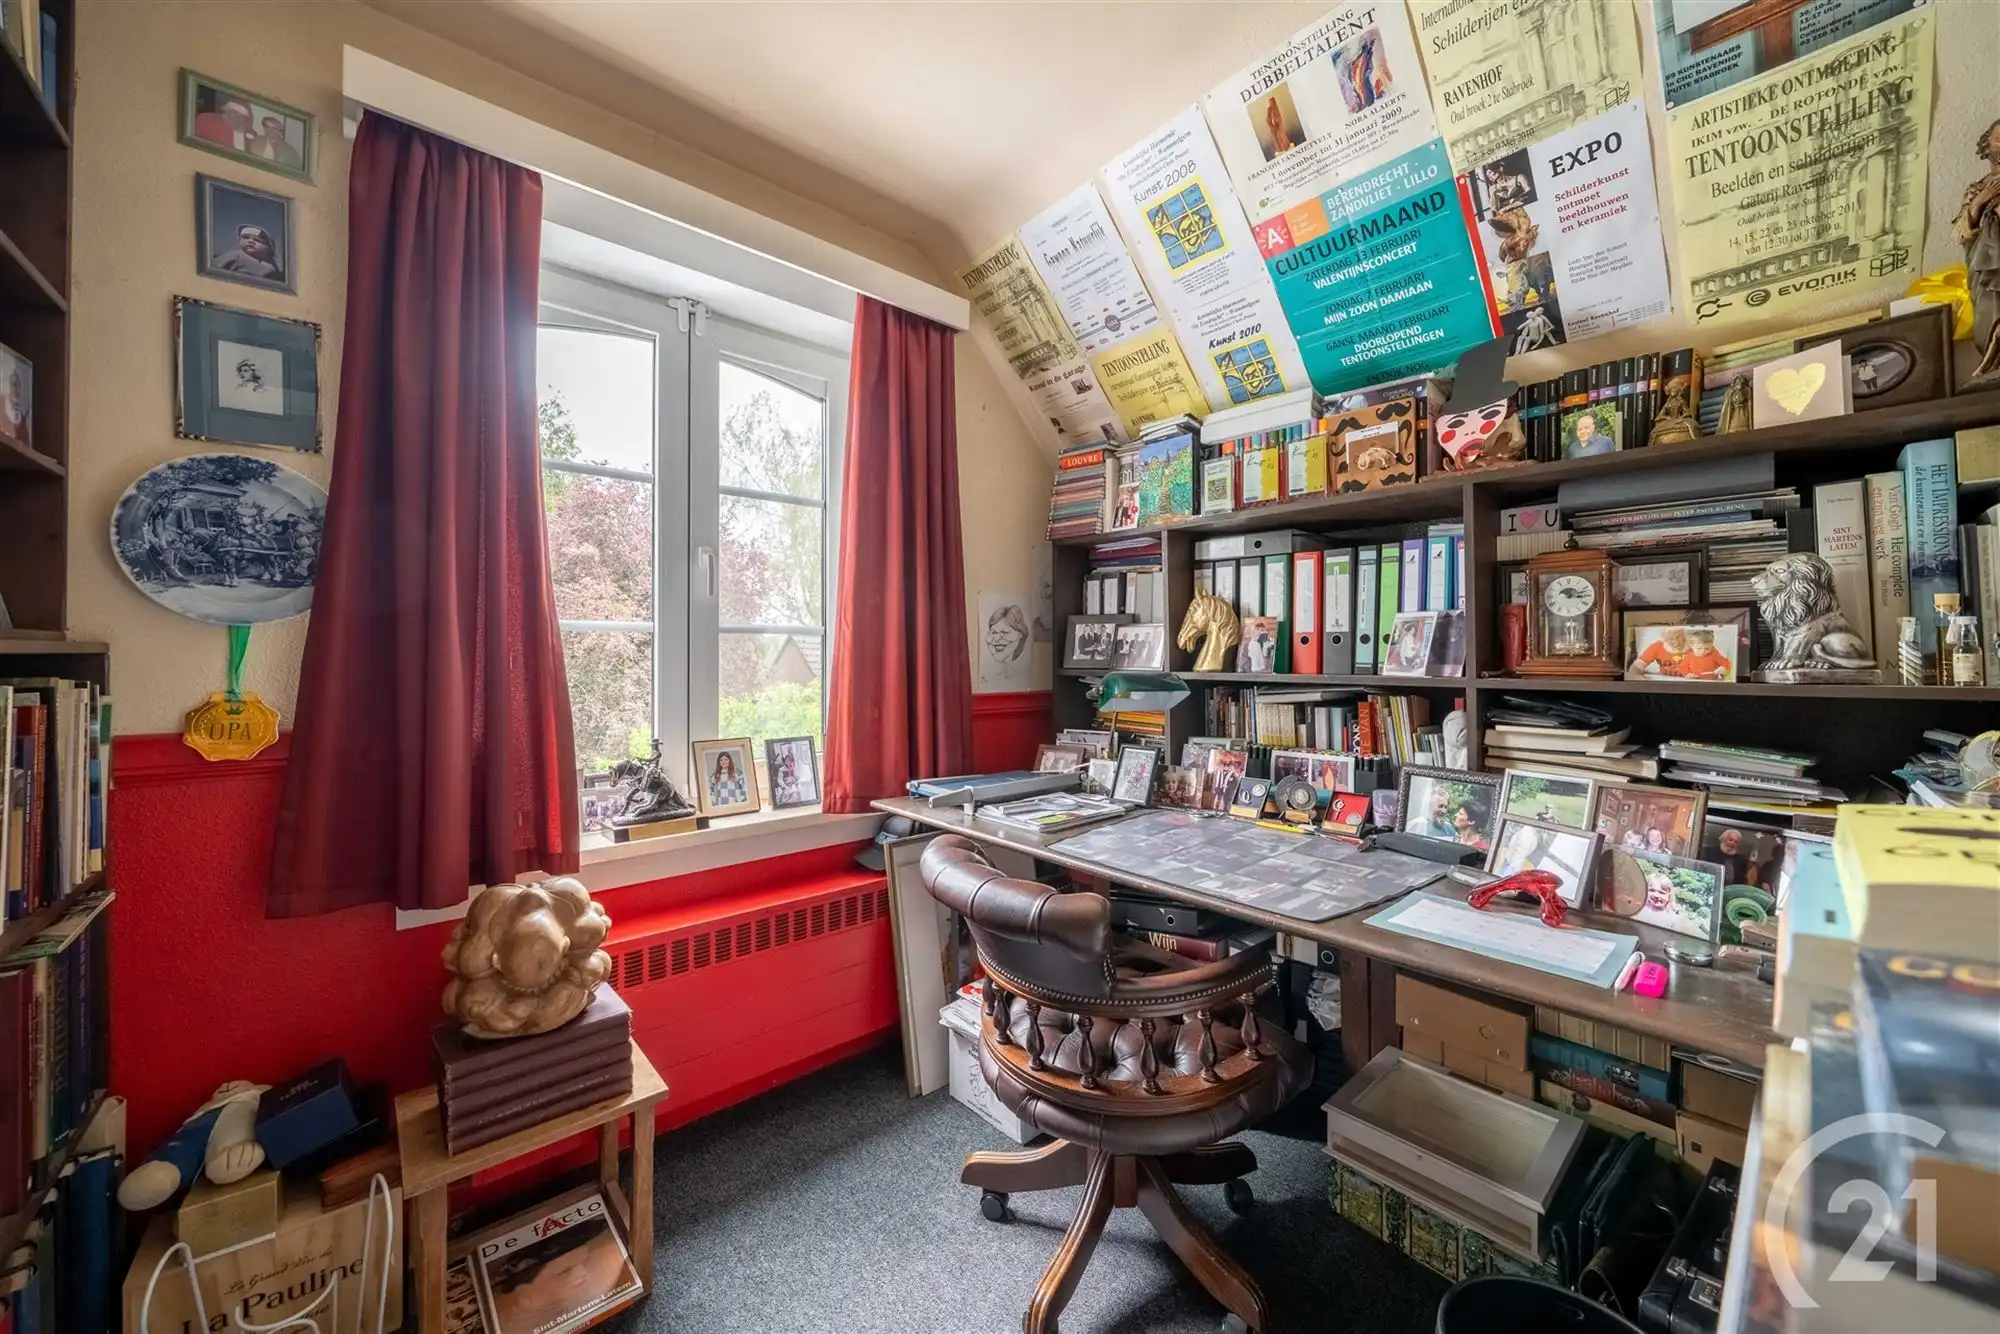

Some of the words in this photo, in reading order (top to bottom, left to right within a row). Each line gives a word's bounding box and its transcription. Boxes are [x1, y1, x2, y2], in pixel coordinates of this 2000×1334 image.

[1250, 9, 1354, 80] TENTOONSTELLING
[1432, 4, 1508, 54] Schilderijen
[1240, 8, 1376, 103] DUBBELTALENT
[1676, 72, 1694, 84] CHC
[1695, 52, 1743, 76] RAVENHOF
[1677, 44, 1742, 75] KUNSTENAARS
[1443, 64, 1503, 107] RAVENHOF
[1501, 73, 1534, 101] Stabroek
[1667, 81, 1692, 96] PUTTE
[1694, 62, 1740, 85] STABROEK
[1691, 84, 1778, 131] ARTISTIEKE
[1780, 36, 1898, 96] ONTMOETING
[1345, 114, 1368, 130] NORA
[1369, 94, 1407, 117] ALAERTS
[1685, 75, 1914, 179] TENTOONSTELLING
[1691, 130, 1722, 148] IKIM
[1770, 105, 1789, 120] DE
[1793, 72, 1869, 110] ROTONDE
[1277, 151, 1318, 178] november
[1320, 146, 1333, 157] tot
[1334, 138, 1345, 149] 31
[1346, 120, 1379, 143] januari
[1381, 106, 1403, 124] 2009
[1548, 131, 1623, 178] EXPO
[1133, 180, 1164, 205] Kunst
[1165, 160, 1197, 188] 2008
[1711, 170, 1765, 198] Beelden
[1768, 166, 1785, 180] en
[1789, 132, 1876, 174] schilderijen
[1326, 162, 1410, 210] BERENDRECHT
[1331, 185, 1393, 222] ZANDVLIET
[1404, 164, 1438, 190] LILLO
[1554, 167, 1630, 202] Schilderkunst
[1557, 190, 1601, 213] ontmoet
[1740, 188, 1778, 210] Galerij
[1781, 167, 1840, 198] Ravenhof
[1558, 192, 1629, 223] beeldhouwen
[1561, 224, 1574, 234] en
[1577, 204, 1628, 228] keramiek
[1799, 208, 1836, 227] oktober
[1275, 191, 1446, 276] CULTUURMAAND
[1745, 245, 1761, 255] van
[1304, 258, 1351, 282] ZATERDAG
[1355, 249, 1368, 262] 13
[1370, 228, 1422, 257] FEBRUARI
[1313, 242, 1418, 290] VALENTIJNSCONCERT
[1323, 311, 1348, 326] MIJN
[1350, 301, 1378, 317] ZOON
[1380, 280, 1433, 307] DAMIAAN
[1324, 295, 1363, 315] ZONDAG
[1375, 271, 1425, 299] FEBRUARI
[1208, 331, 1236, 349] Kunst
[1239, 323, 1262, 339] 2010
[1326, 334, 1356, 351] GANSE
[1358, 322, 1396, 343] MAAND
[1398, 305, 1450, 332] FEBRUARI
[1354, 325, 1422, 354] DOORLOPEND
[1101, 339, 1171, 378] TENTOONSTELLING
[1340, 329, 1445, 368] TENTOONSTELLINGEN
[1028, 380, 1046, 392] Kunst
[1053, 374, 1062, 384] de
[1062, 363, 1087, 382] garage
[1067, 455, 1097, 467] LOUVRE
[1915, 466, 1927, 476] de
[1931, 463, 1948, 485] HET
[1889, 485, 1902, 503] Van
[1914, 477, 1929, 527] kunstenaars
[1508, 513, 1517, 532] I
[1544, 508, 1558, 527] U
[1832, 526, 1852, 535] SINT
[1887, 503, 1902, 531] Gogh
[1931, 486, 1951, 576] IMPRESSIONIS
[1823, 533, 1863, 544] MARTENS
[1829, 542, 1858, 552] LATEM
[1875, 537, 1889, 560] werk
[1891, 536, 1904, 554] Het
[1889, 555, 1905, 597] complete
[209, 722, 252, 741] OPA
[1360, 708, 1371, 733] VAN
[1148, 930, 1177, 951] Wijn
[482, 1237, 518, 1258] De
[241, 1258, 364, 1320] Pauline
[533, 1281, 632, 1334] Sint-Martens-Latem
